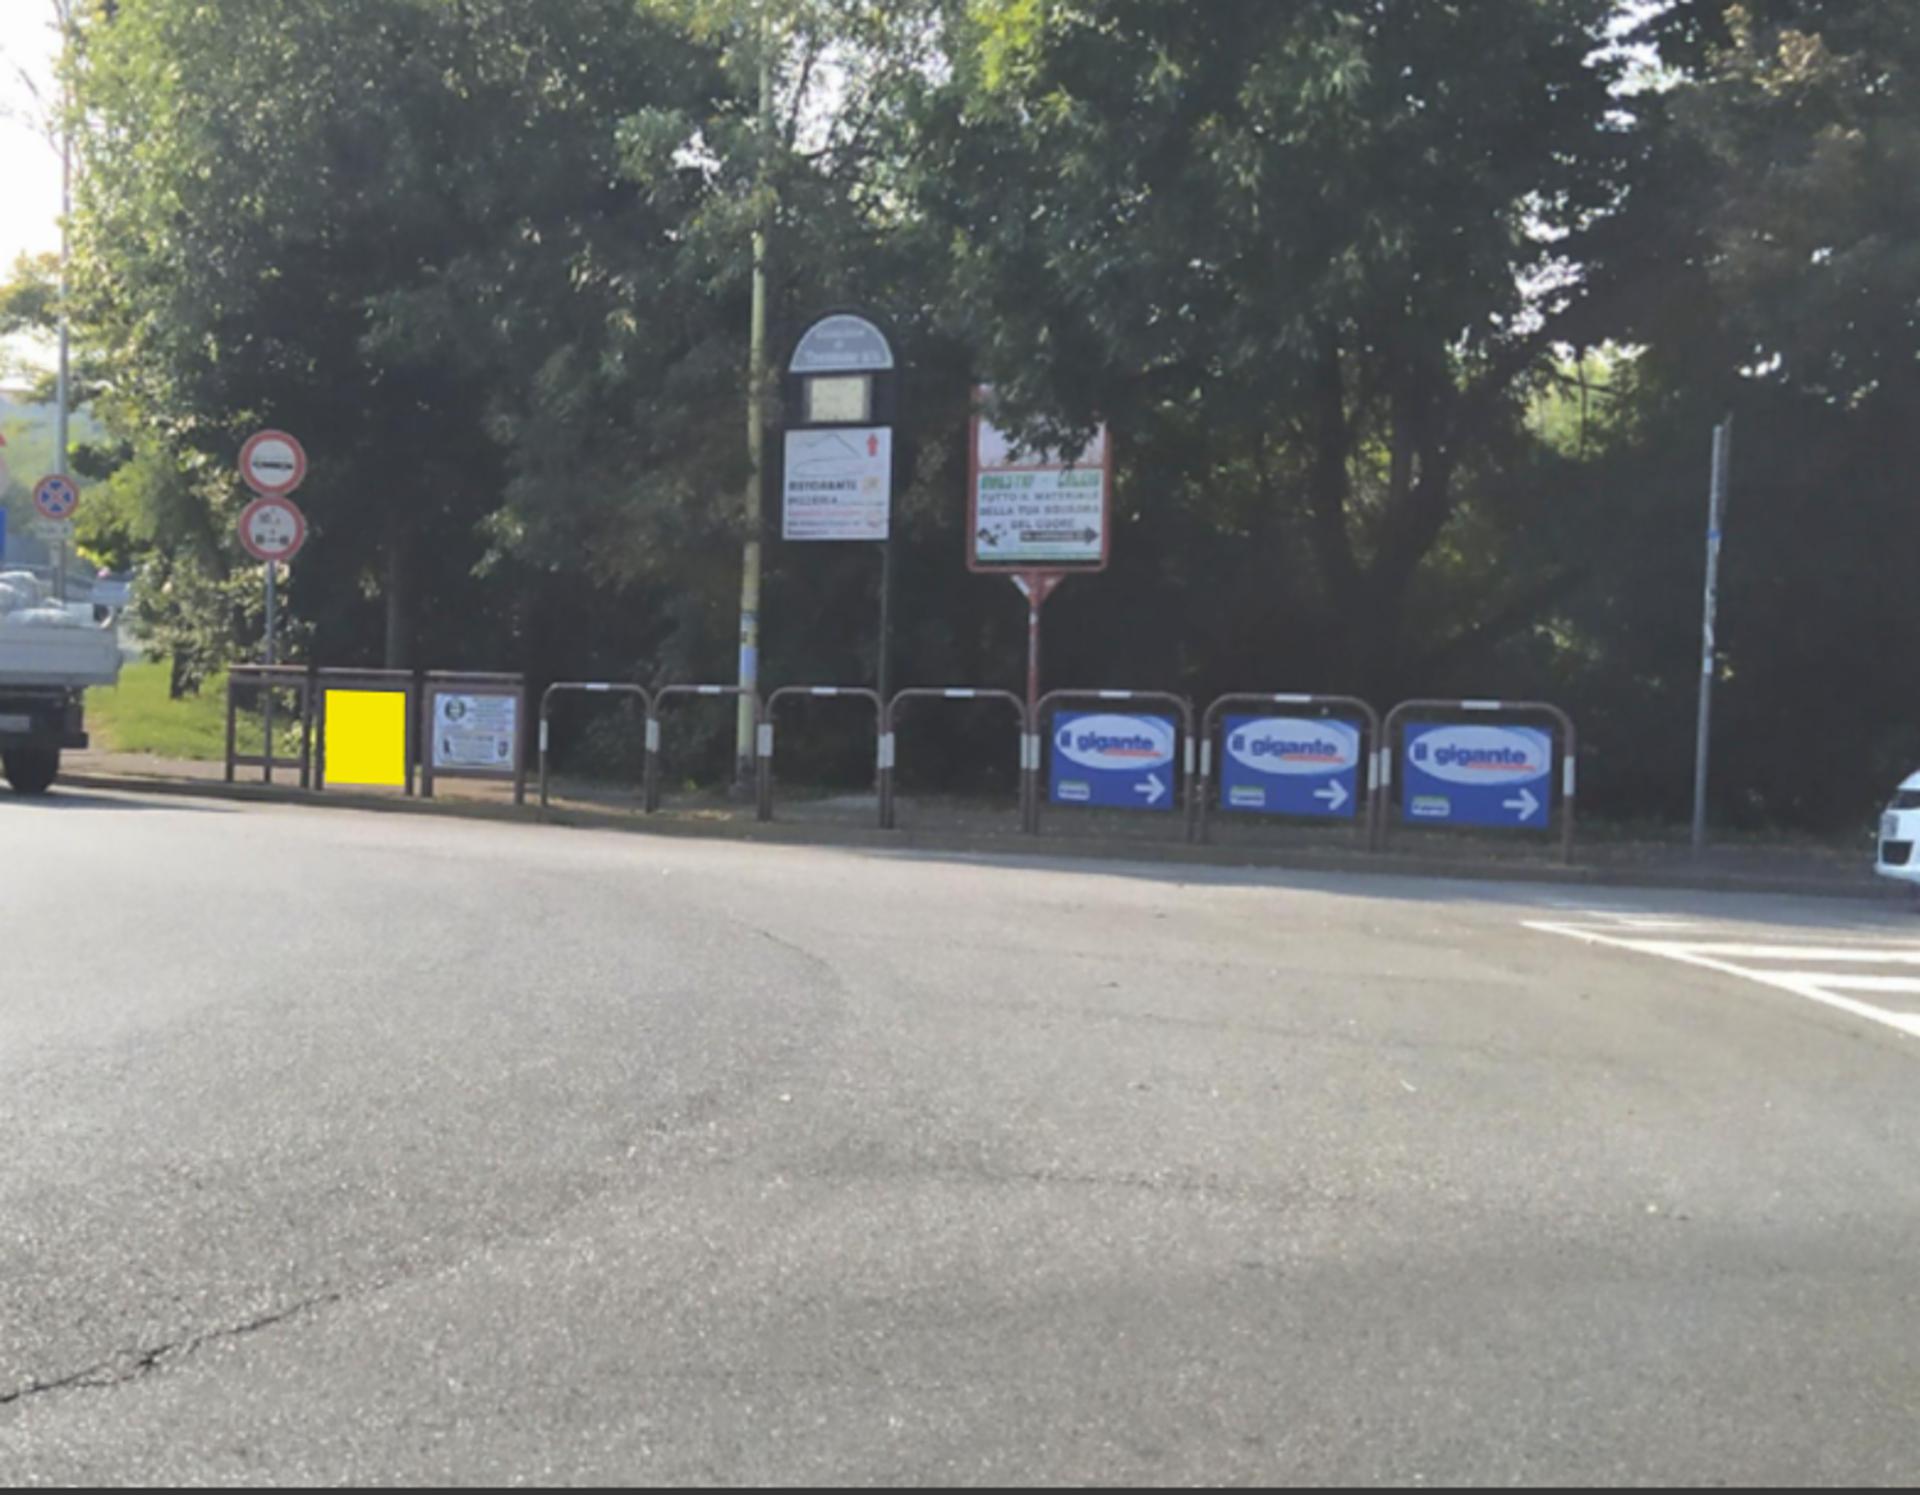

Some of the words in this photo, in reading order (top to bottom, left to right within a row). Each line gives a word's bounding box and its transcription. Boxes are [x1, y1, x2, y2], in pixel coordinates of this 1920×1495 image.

[1060, 731, 1071, 750] il
[1077, 731, 1155, 752] gigante
[1232, 735, 1245, 752] il
[1251, 735, 1338, 756] gigante
[1413, 742, 1427, 761] il
[1434, 744, 1526, 766] gigante
